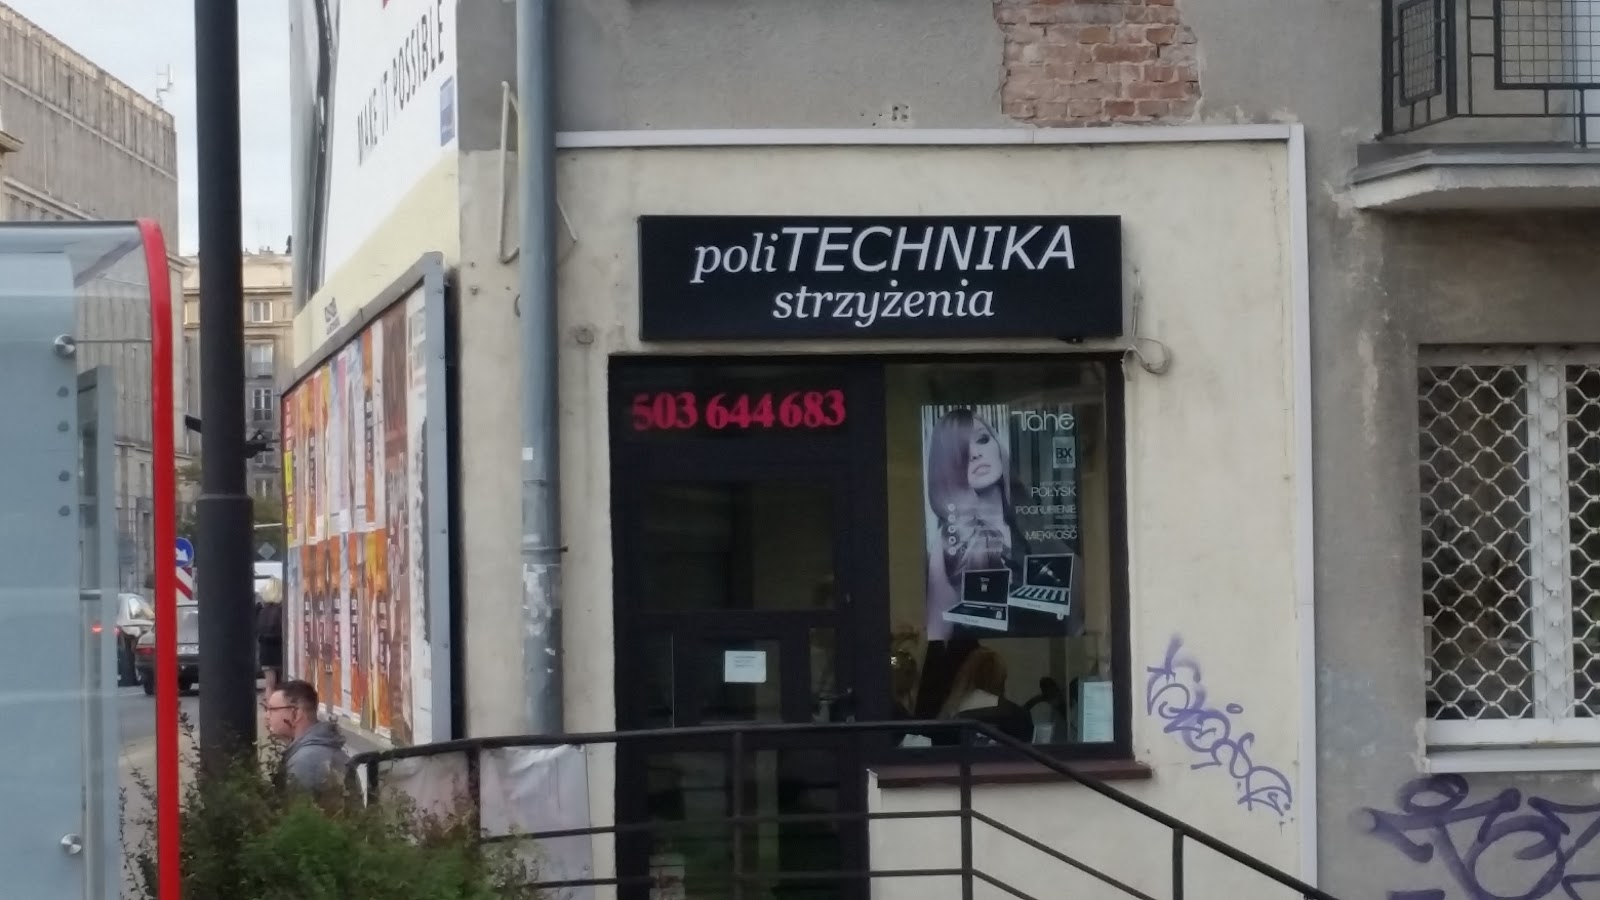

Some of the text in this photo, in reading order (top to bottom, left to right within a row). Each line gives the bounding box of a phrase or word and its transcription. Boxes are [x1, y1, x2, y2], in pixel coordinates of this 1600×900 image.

[357, 0, 445, 168] MAKE IT POSSIBLE
[690, 224, 1077, 284] poliTECHNIKA
[772, 278, 995, 328] strzyżenia
[631, 389, 846, 431] 503 644 683
[1011, 410, 1075, 433] Tahe
[1031, 486, 1077, 498] POŁYSK
